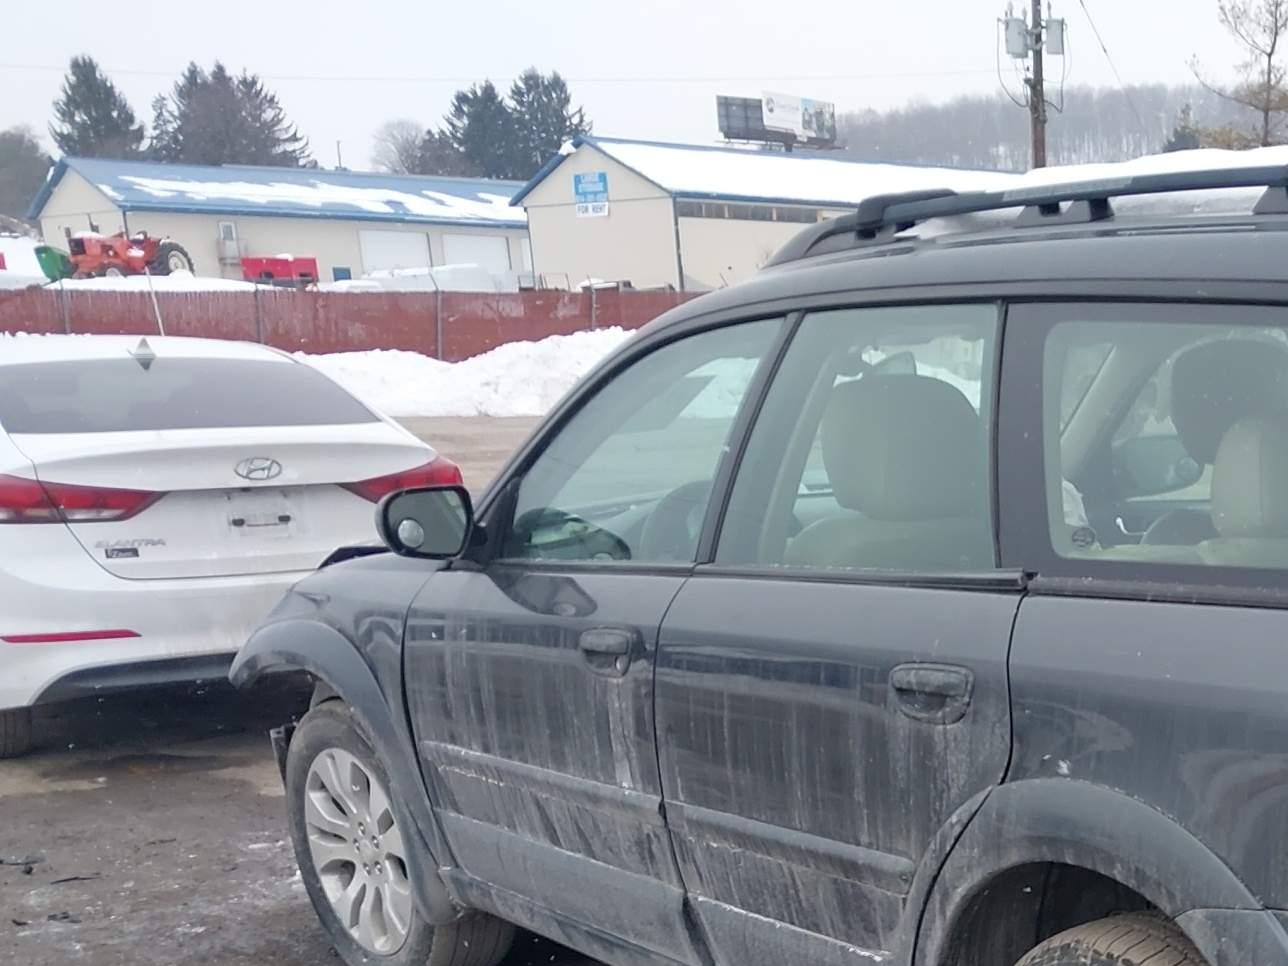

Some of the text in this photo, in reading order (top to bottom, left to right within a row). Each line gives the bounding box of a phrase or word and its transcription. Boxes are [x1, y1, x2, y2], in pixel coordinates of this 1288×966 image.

[577, 204, 606, 214] FOR RENT
[95, 538, 166, 548] ELANTRA
